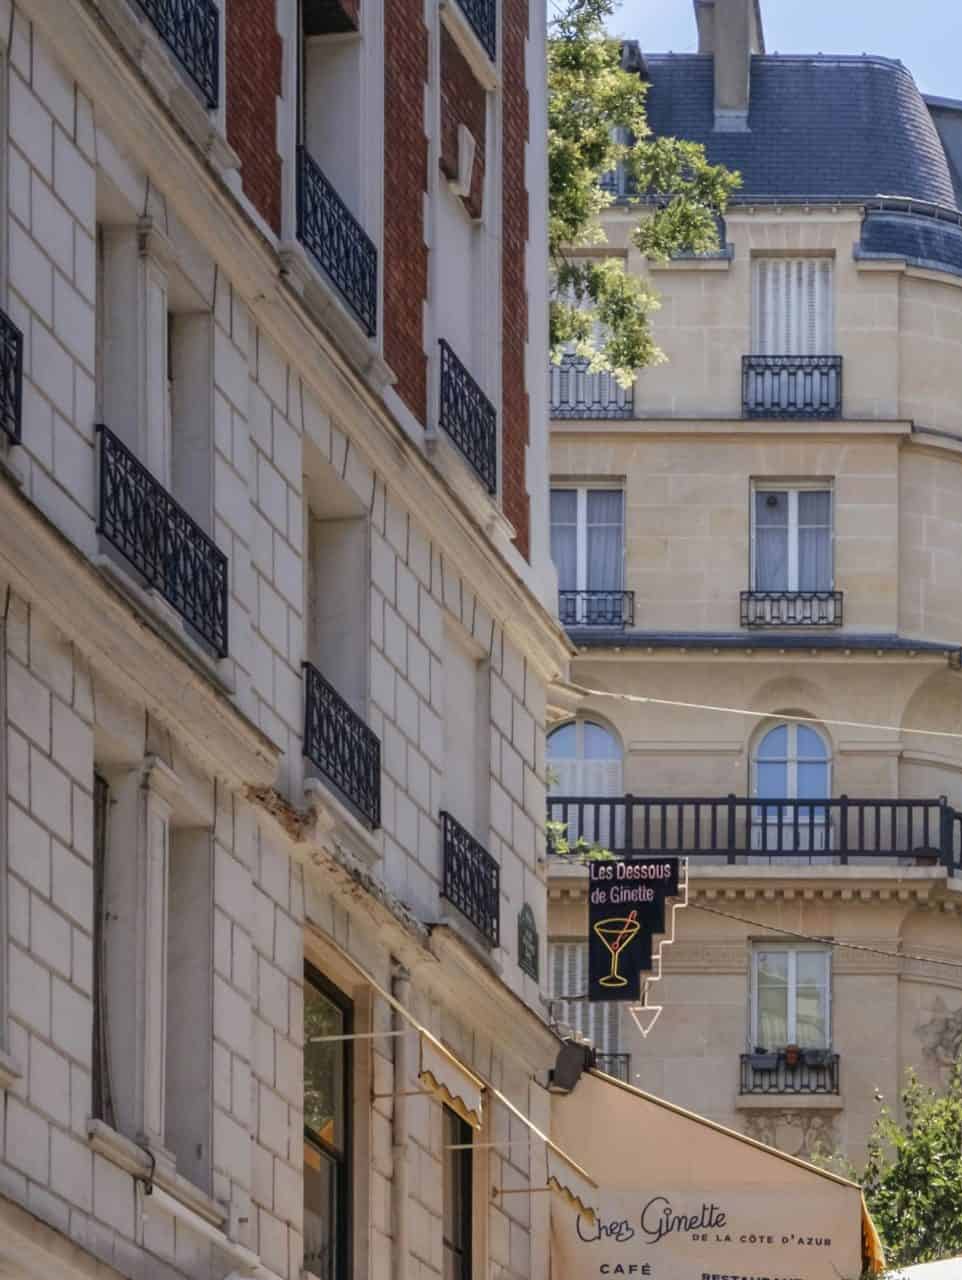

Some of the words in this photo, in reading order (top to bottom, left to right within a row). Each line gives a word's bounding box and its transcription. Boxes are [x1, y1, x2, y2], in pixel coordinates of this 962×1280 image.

[591, 863, 613, 881] Les
[616, 862, 671, 880] Dessous
[591, 887, 607, 904] de
[609, 885, 654, 903] Ginette
[640, 1196, 727, 1245] Ginette
[692, 1233, 708, 1242] DE
[716, 1233, 731, 1243] LA
[599, 1263, 652, 1275] CAFÉ
